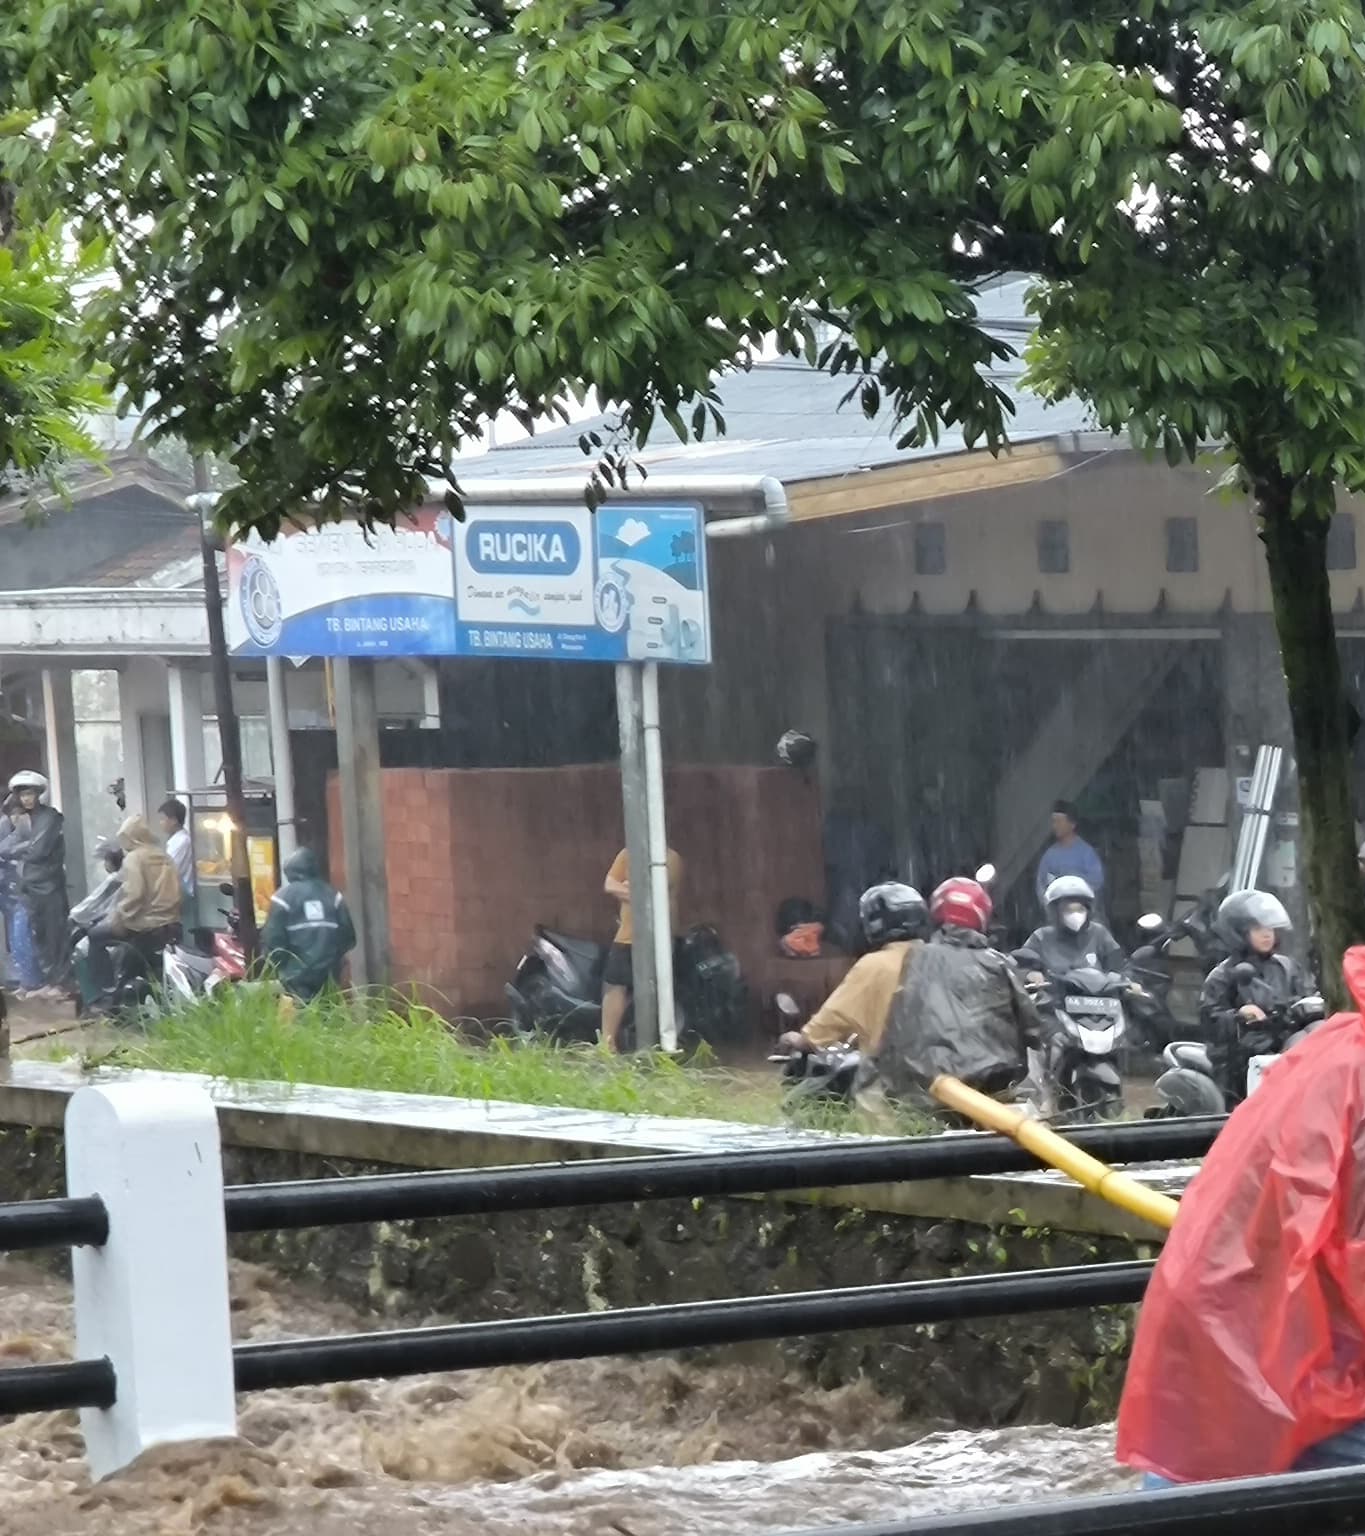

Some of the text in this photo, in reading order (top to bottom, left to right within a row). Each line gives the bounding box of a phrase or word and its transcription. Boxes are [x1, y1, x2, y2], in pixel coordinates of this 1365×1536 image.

[479, 532, 567, 563] RUCIKA
[344, 617, 388, 632] BINTANG
[483, 630, 522, 649] BINTANG
